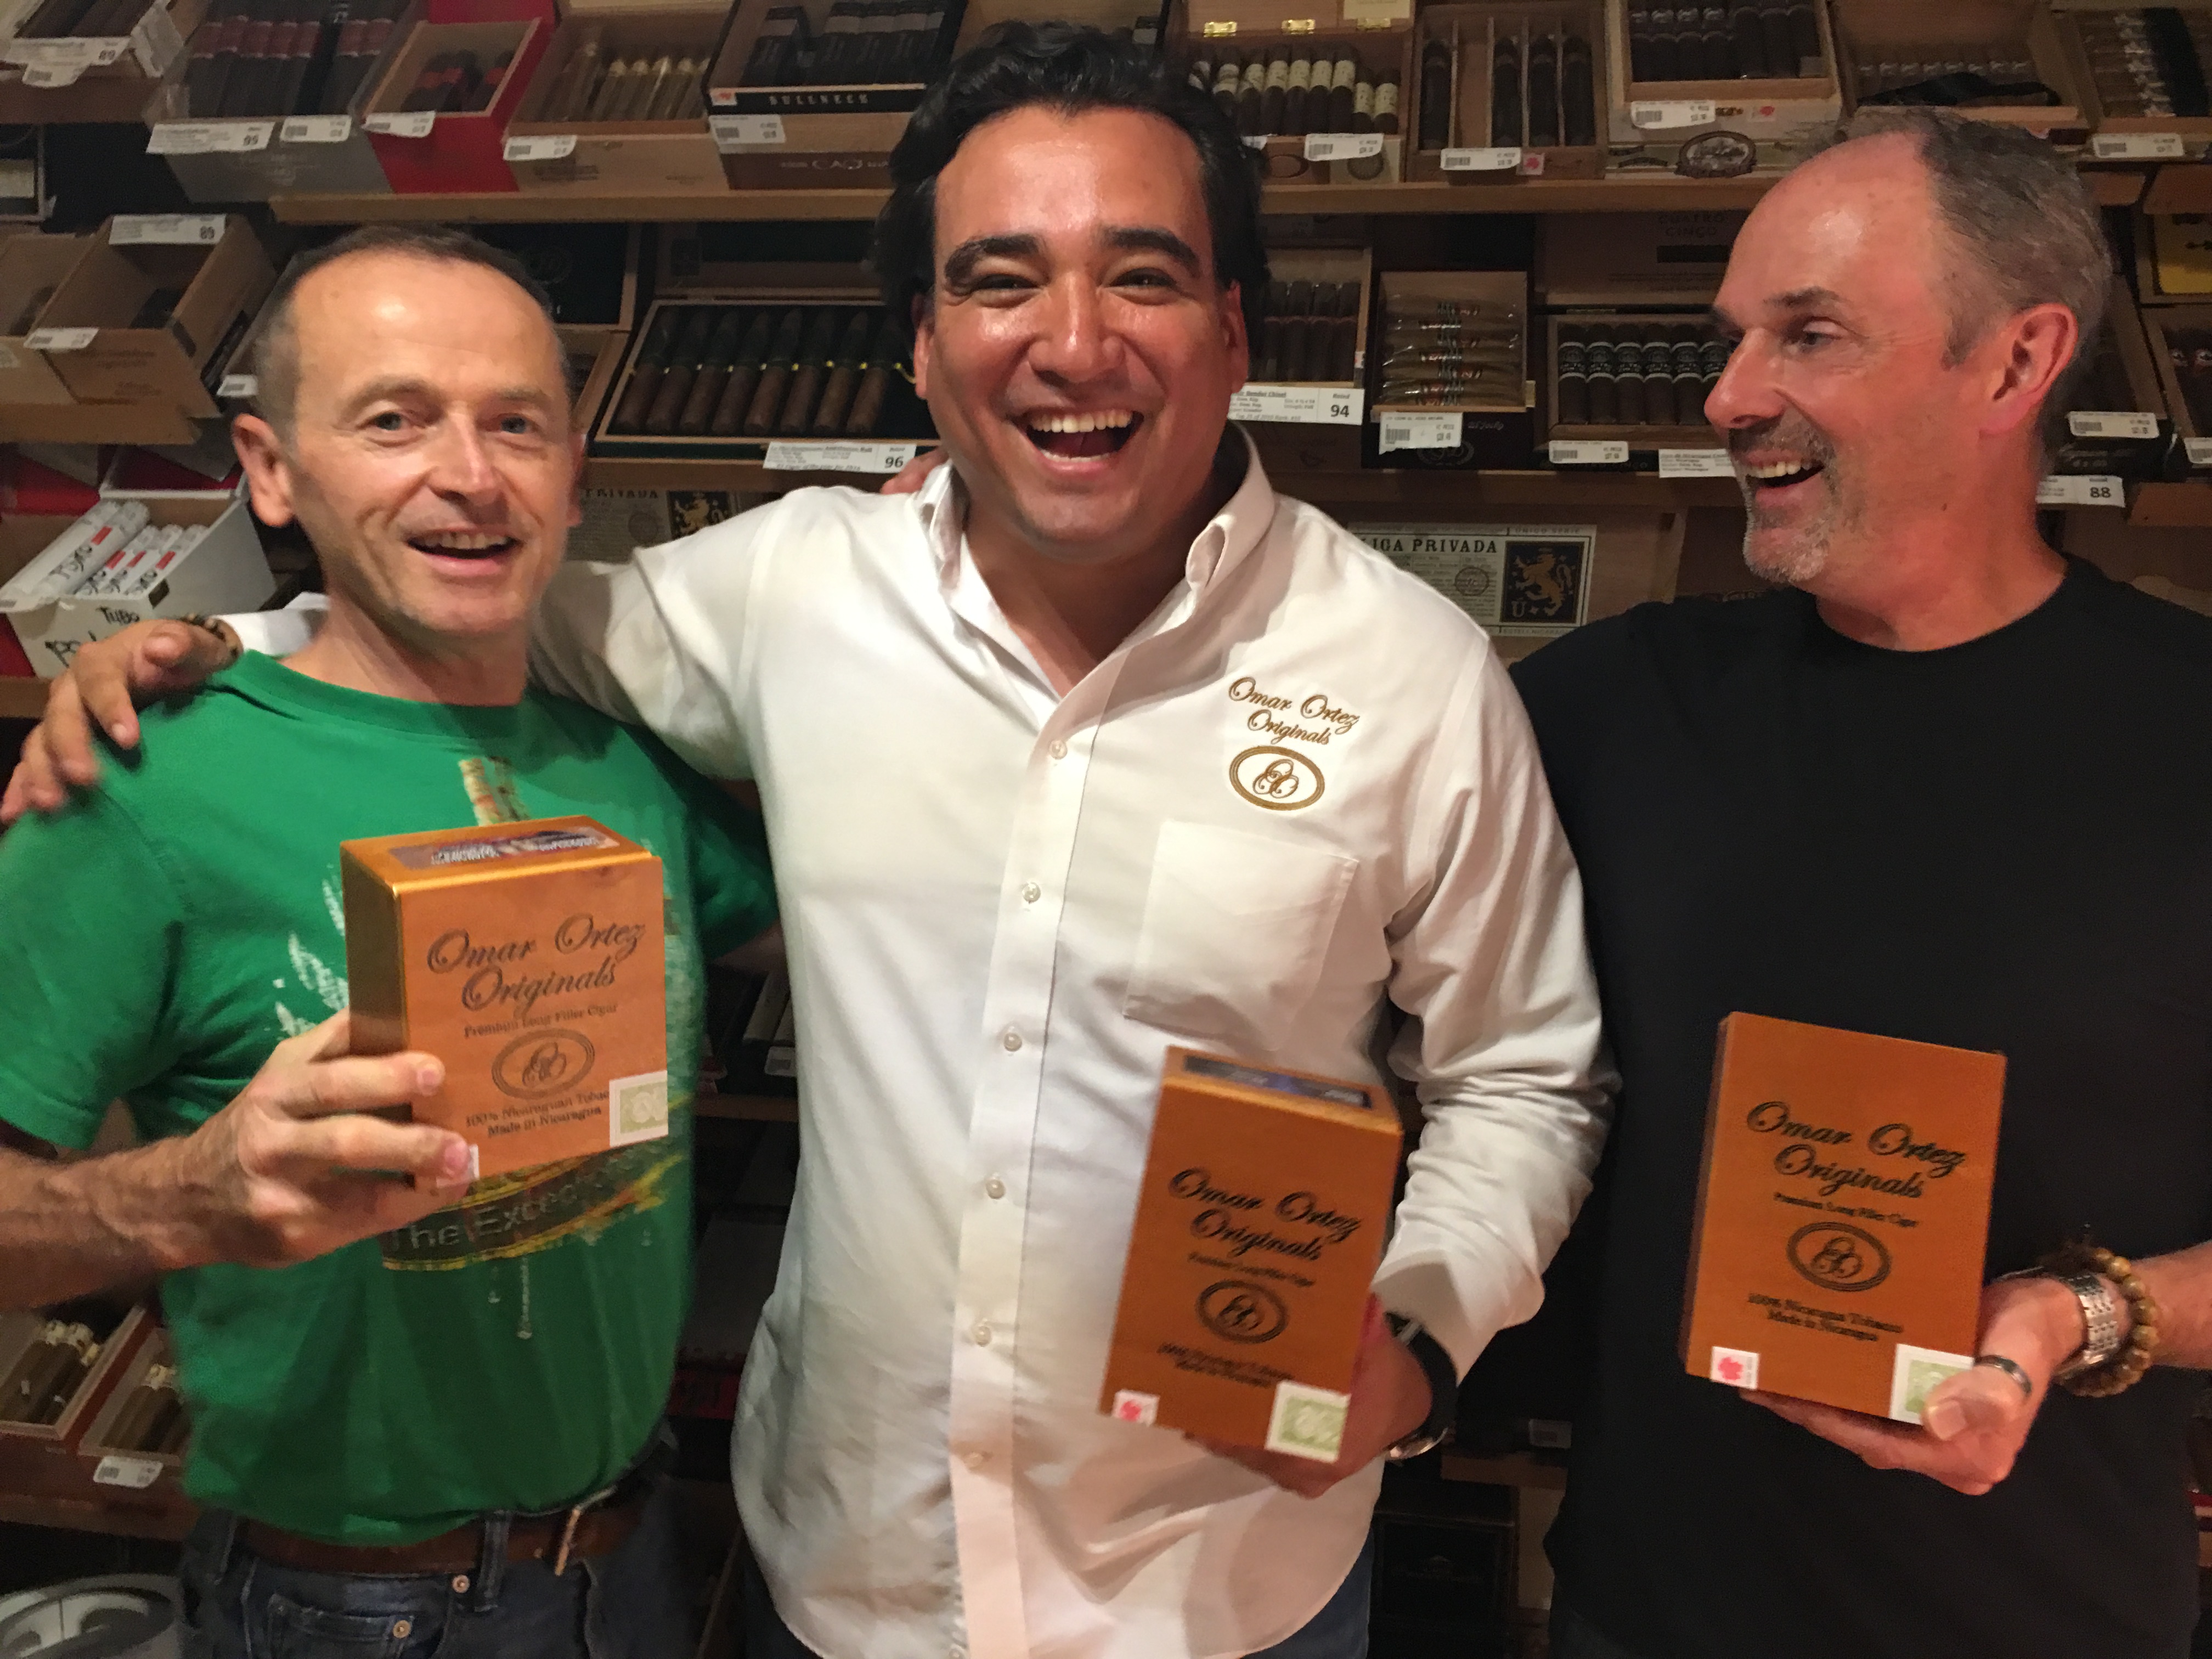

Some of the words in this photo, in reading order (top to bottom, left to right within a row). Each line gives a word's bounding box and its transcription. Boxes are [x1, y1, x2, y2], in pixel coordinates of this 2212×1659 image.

[1330, 404, 1350, 417] 94
[884, 456, 904, 469] 96
[2089, 487, 2112, 498] 88
[1360, 538, 1403, 552] IGA
[1412, 539, 1497, 553] PRIVADA
[1229, 676, 1293, 710] Omar
[1300, 694, 1360, 735] Ortez
[1248, 709, 1332, 745] Originals
[426, 927, 537, 975] Omar
[555, 913, 646, 962] Ortez
[461, 956, 616, 1020] Originals
[1746, 1101, 1853, 1146] Omar
[1867, 1122, 1967, 1178] Ortez
[1167, 1166, 1263, 1210] Omar
[1773, 1143, 1925, 1199] Originals
[1190, 1208, 1323, 1261] Originals
